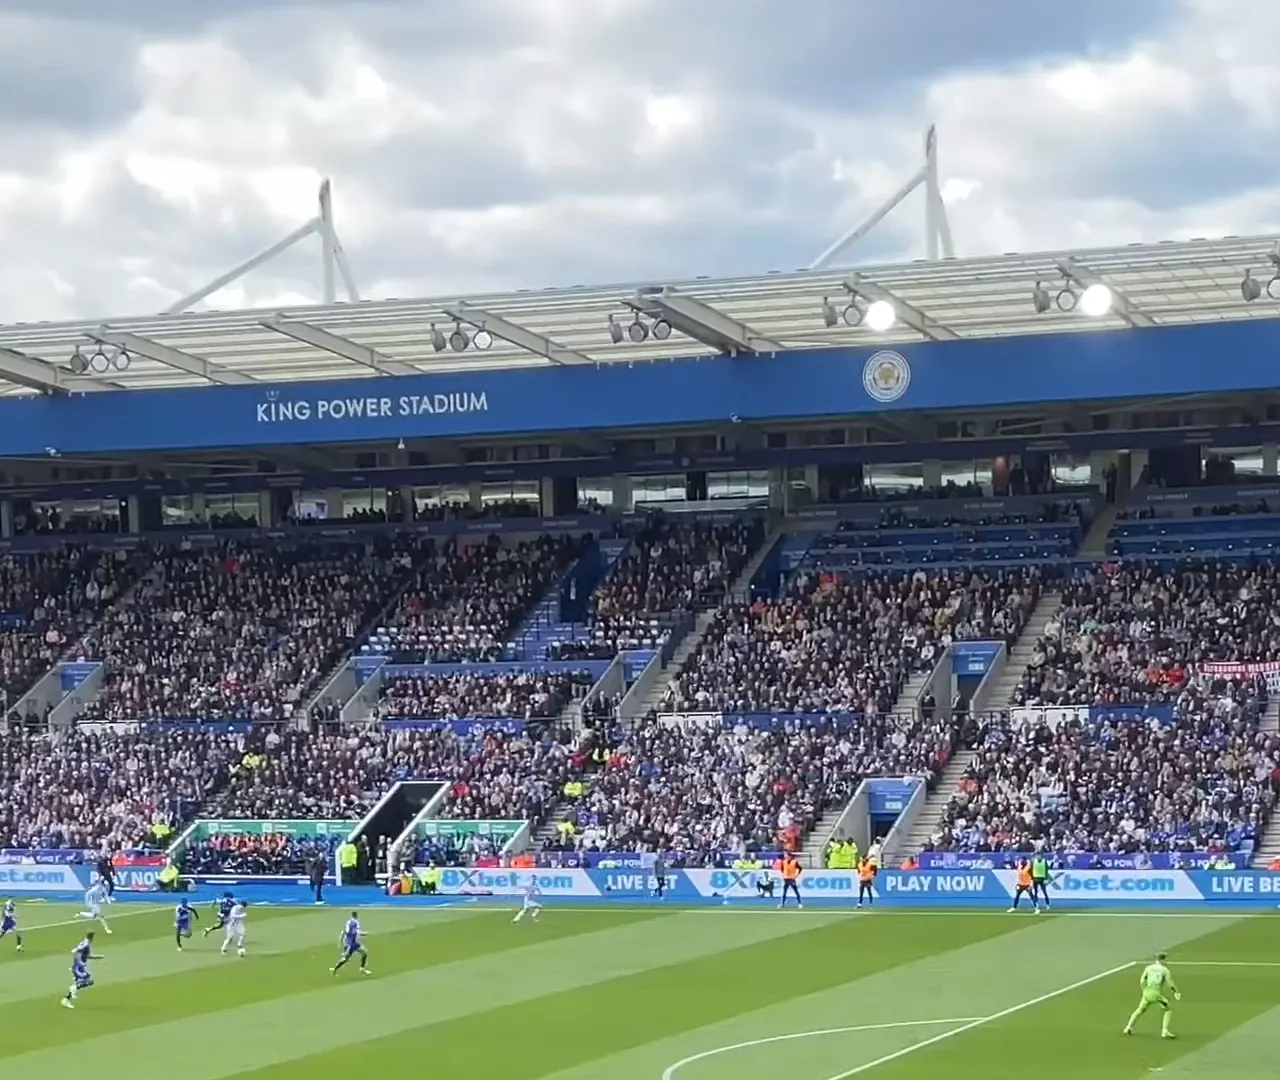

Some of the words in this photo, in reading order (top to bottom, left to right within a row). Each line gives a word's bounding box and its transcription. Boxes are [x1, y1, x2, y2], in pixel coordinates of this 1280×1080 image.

[257, 402, 310, 422] KING
[318, 397, 392, 419] POWER
[399, 391, 488, 416] STADIUM
[608, 875, 643, 889] LIVE
[886, 876, 930, 891] PLAY
[937, 876, 984, 891] NOW
[1044, 872, 1175, 893] Xbet.com
[1212, 877, 1254, 892] LIVE
